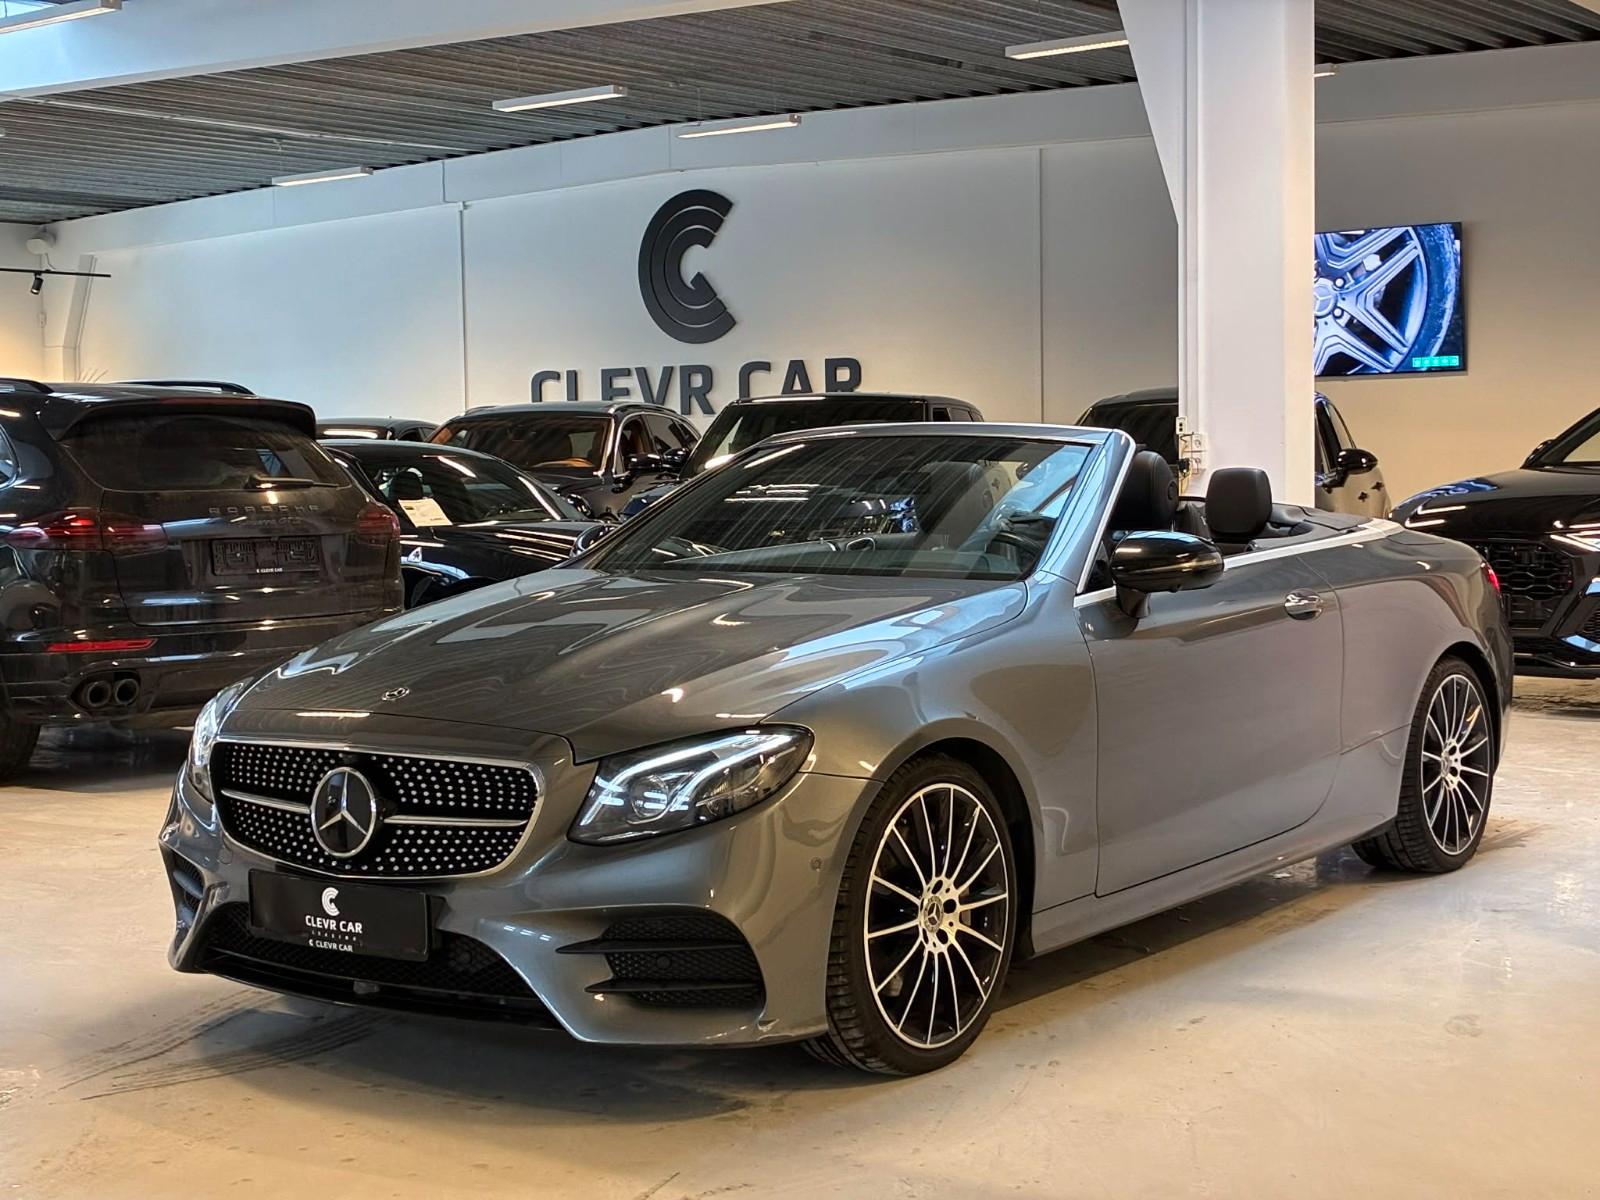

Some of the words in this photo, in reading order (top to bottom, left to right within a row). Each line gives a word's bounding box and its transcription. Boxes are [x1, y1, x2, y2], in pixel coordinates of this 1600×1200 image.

[738, 357, 863, 401] CAR
[305, 915, 337, 931] CLEVR
[339, 920, 363, 934] CAR
[315, 940, 337, 950] CLEVR
[338, 943, 353, 952] CAR
